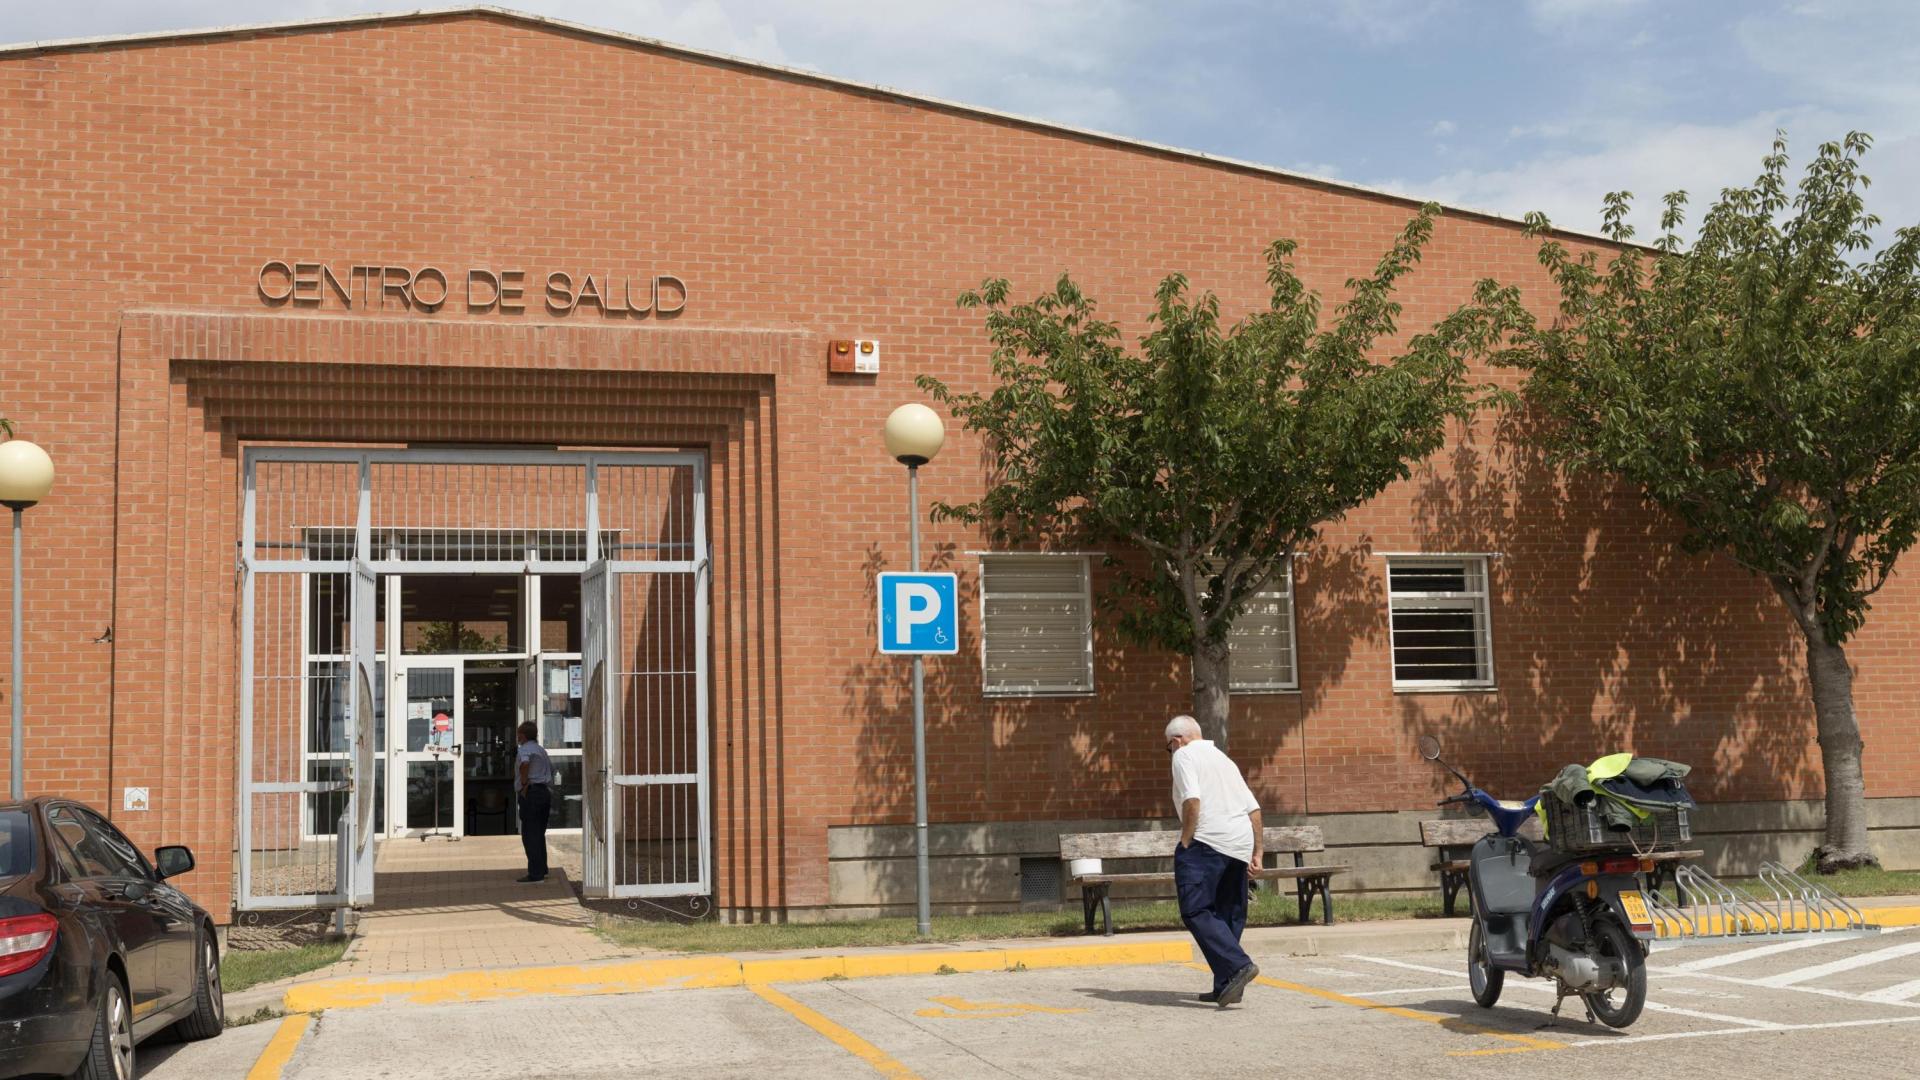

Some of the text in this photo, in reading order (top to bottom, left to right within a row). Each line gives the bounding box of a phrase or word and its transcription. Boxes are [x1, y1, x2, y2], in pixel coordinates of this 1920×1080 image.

[257, 260, 688, 314] CENTRO DE SALUD
[895, 582, 942, 645] P
